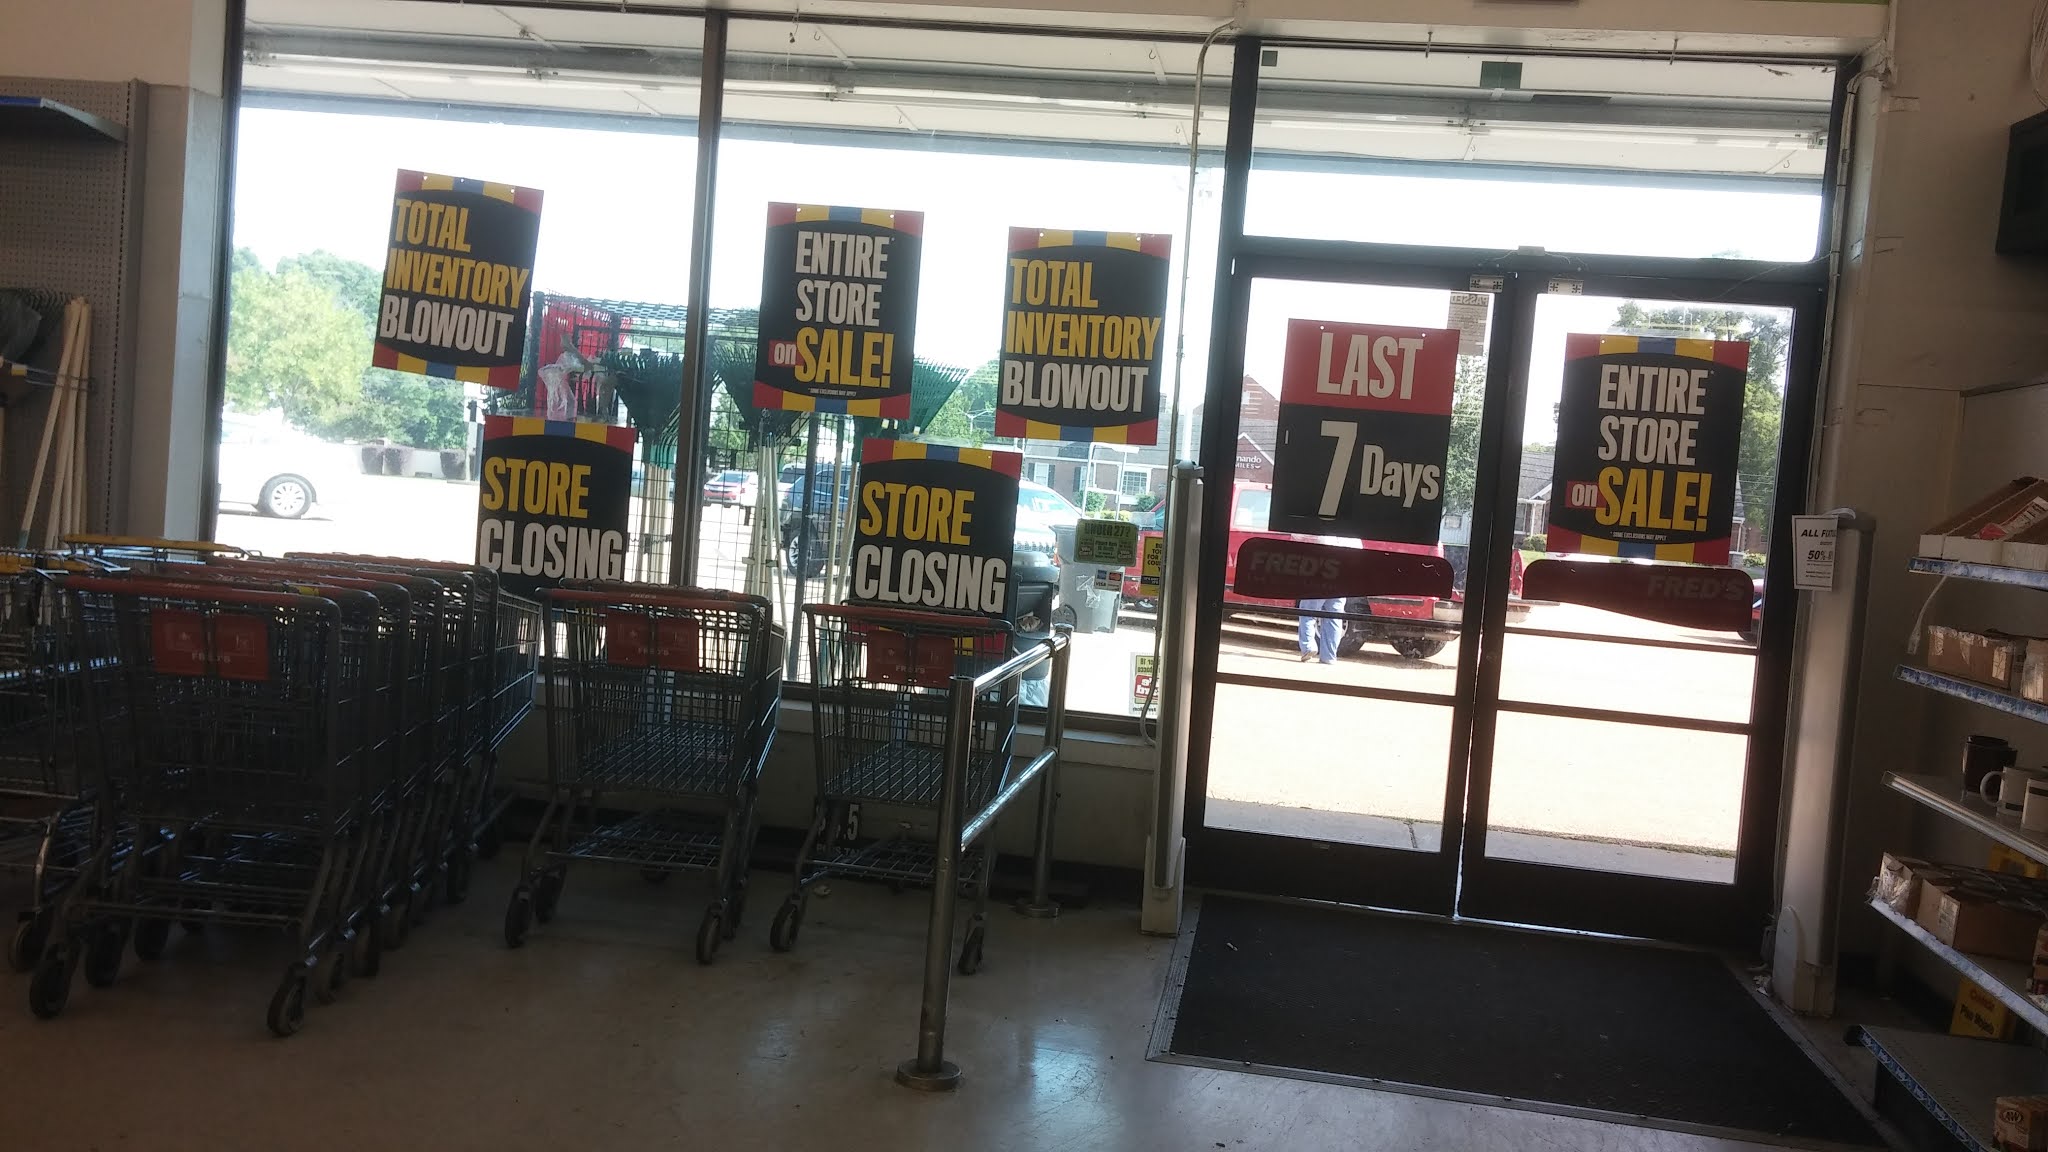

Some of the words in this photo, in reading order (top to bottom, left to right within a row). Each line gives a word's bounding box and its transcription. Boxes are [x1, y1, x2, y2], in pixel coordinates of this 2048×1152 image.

[394, 199, 471, 253] TOTAL
[386, 248, 530, 309] INVENTORY
[795, 231, 889, 279] ENTIRE
[795, 279, 882, 327] STORE
[1009, 258, 1098, 308] TOTAL
[379, 295, 514, 357] BLOWOUT
[1005, 310, 1161, 361] INVENTORY
[774, 342, 797, 365] on
[794, 327, 895, 388] SALE!
[1316, 332, 1424, 400] LAST
[1001, 360, 1148, 413] BLOWOUT
[1598, 364, 1709, 415] ENTIRE
[1598, 416, 1699, 466] STORE
[483, 456, 592, 518] STORE
[1317, 420, 1358, 517] 7
[1359, 444, 1441, 508] Days
[858, 481, 975, 545] STORE
[1571, 483, 1598, 507] on
[1595, 466, 1712, 532] SALE!
[479, 518, 624, 581] CLOSING
[1801, 529, 1819, 537] ALL
[855, 544, 1007, 613] CLOSING
[1249, 551, 1342, 579] FRED'S
[1647, 574, 1745, 600] FRED'S
[847, 804, 860, 841] 5
